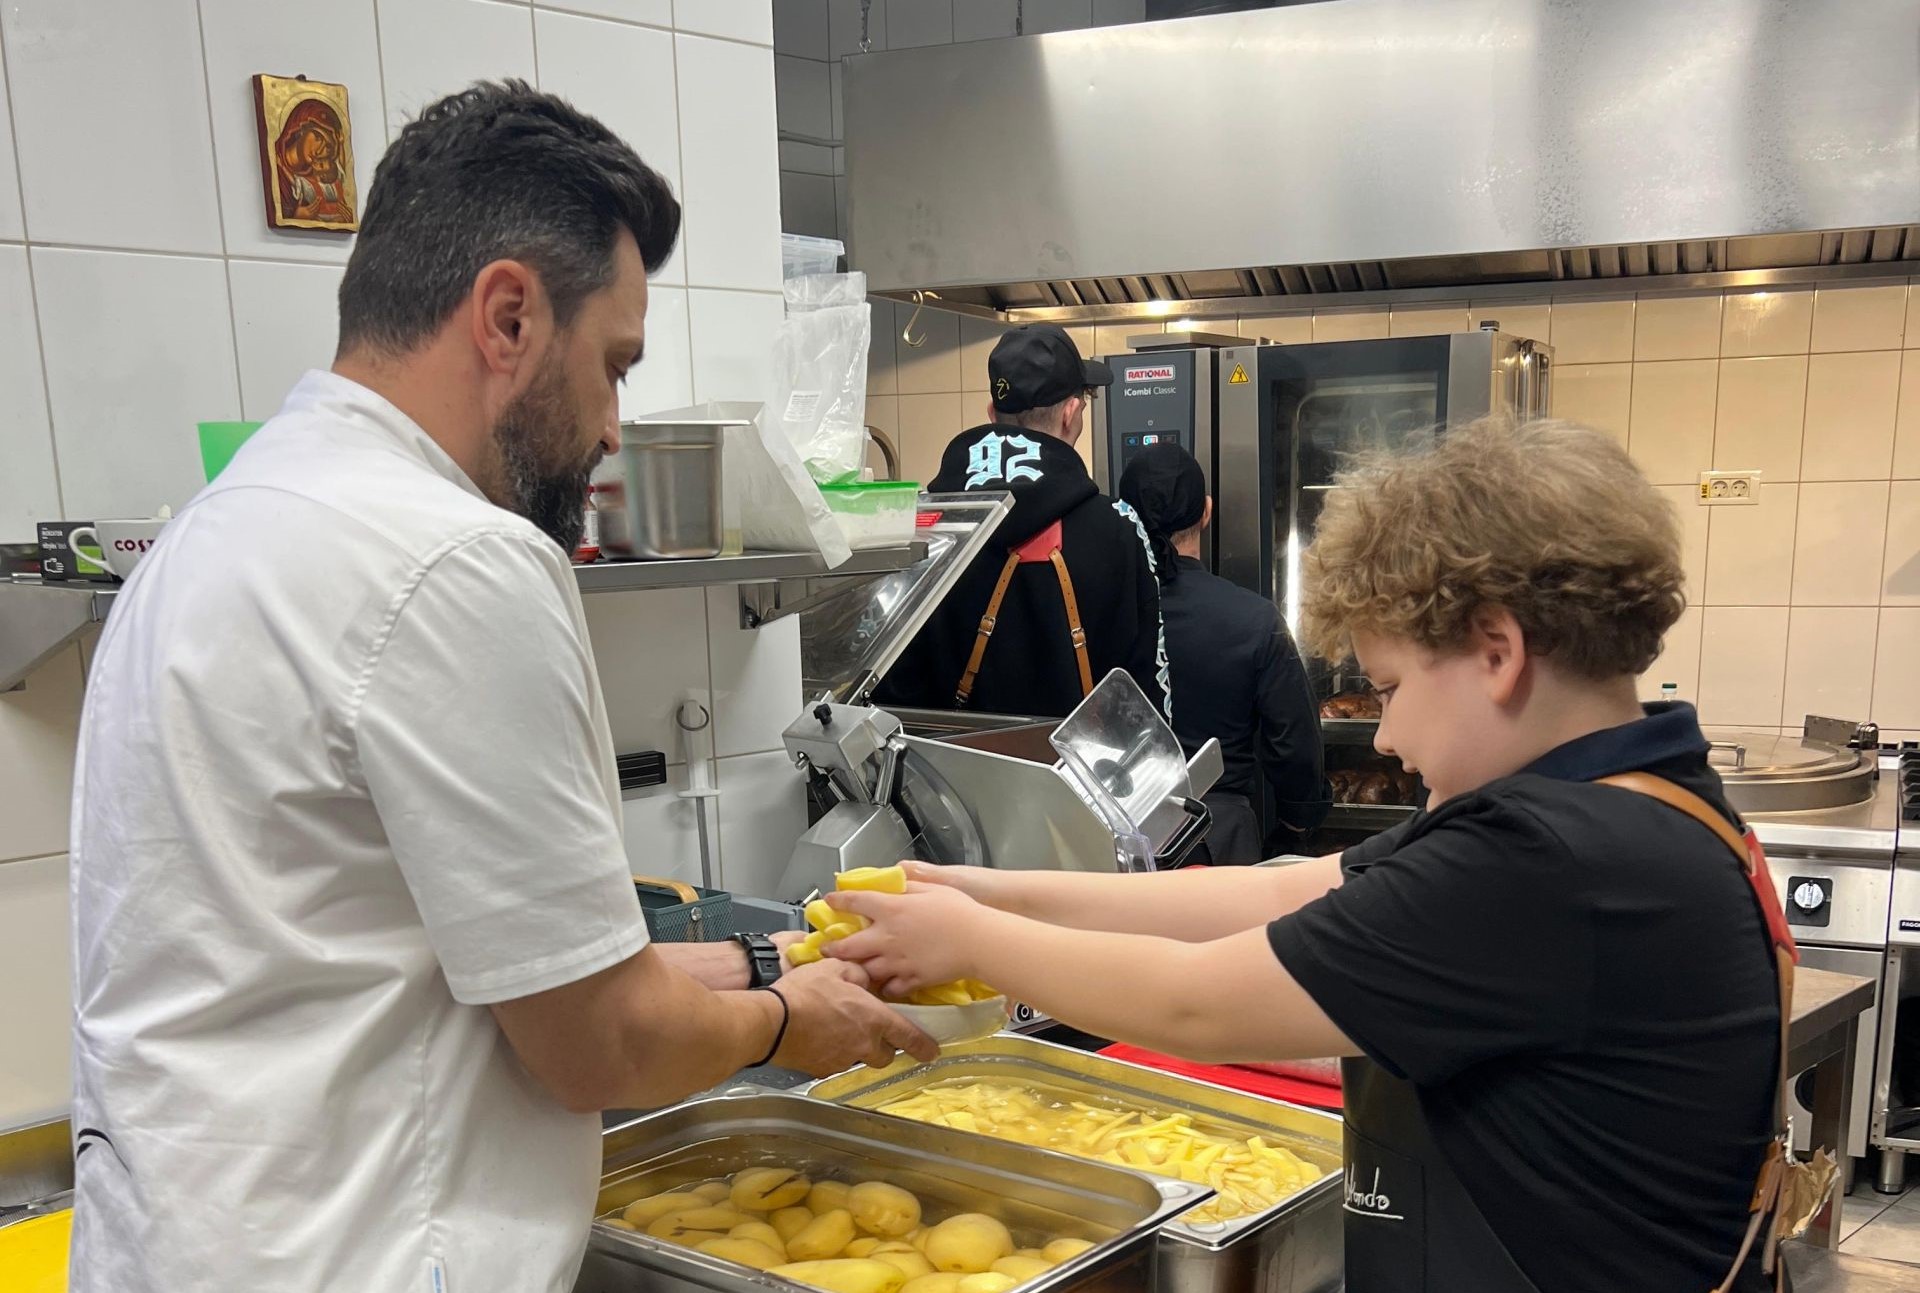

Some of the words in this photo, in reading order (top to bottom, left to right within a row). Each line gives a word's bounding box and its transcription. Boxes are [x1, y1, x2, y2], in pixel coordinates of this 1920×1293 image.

[1127, 369, 1172, 379] RATIONAL
[1124, 387, 1152, 397] iCombi
[1153, 386, 1177, 395] Classic
[964, 431, 1044, 491] 92
